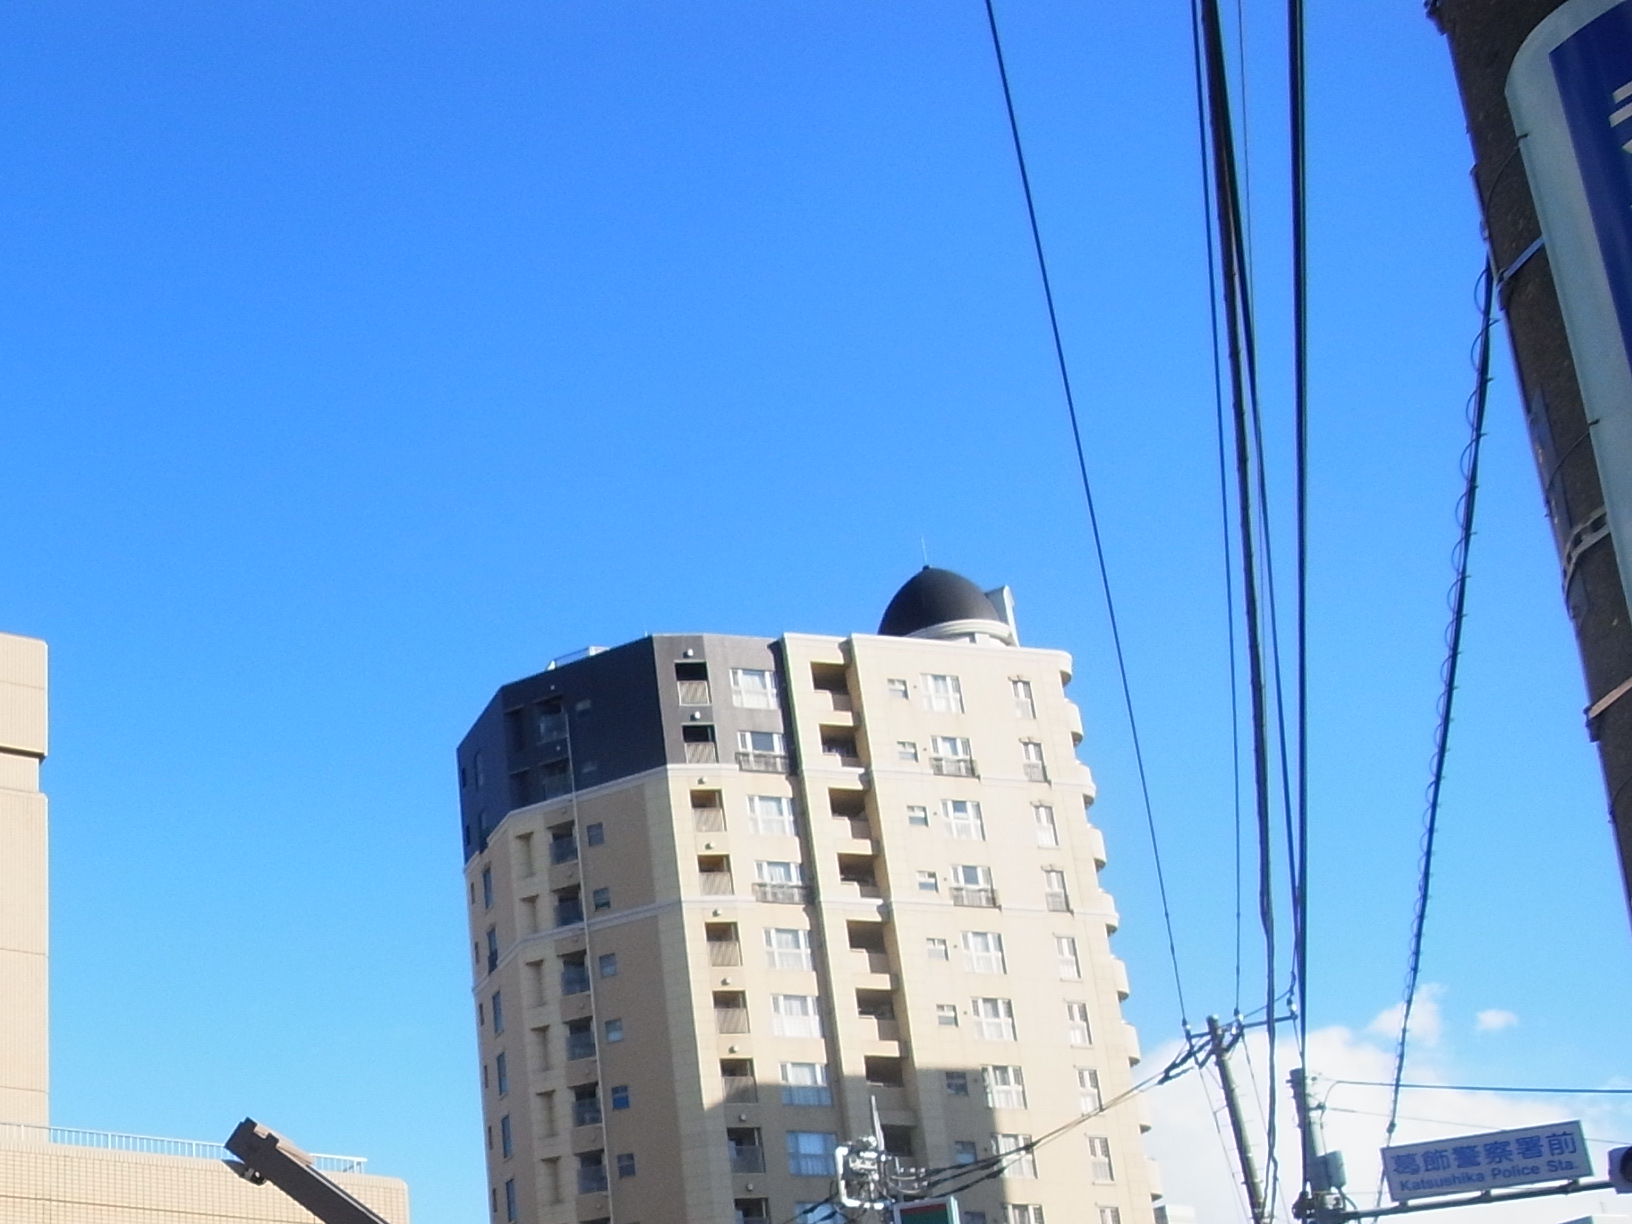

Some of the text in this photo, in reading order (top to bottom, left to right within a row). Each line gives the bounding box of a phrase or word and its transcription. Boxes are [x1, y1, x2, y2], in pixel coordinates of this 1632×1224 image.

[1391, 1131, 1577, 1175] 葛飾警察署前
[1400, 1170, 1485, 1192] Katsushika
[1491, 1162, 1540, 1181] Police
